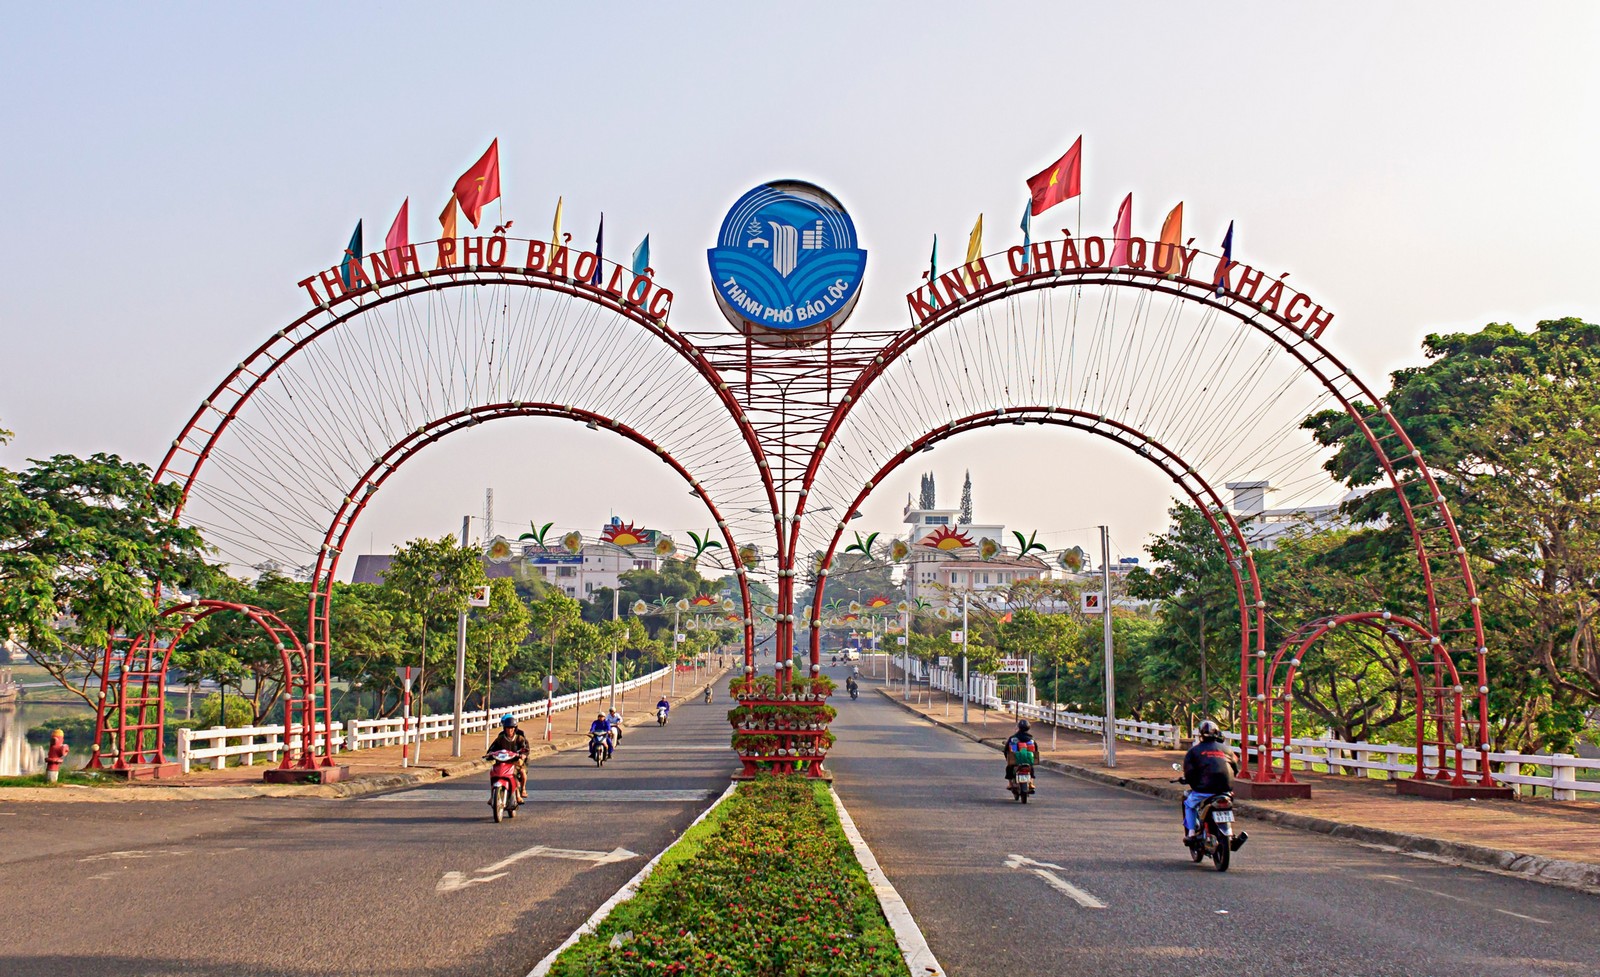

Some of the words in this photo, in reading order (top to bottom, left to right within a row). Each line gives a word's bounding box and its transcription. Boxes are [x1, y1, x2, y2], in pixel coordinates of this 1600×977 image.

[297, 243, 421, 306] THÀNH
[437, 220, 513, 269] PHỐ
[526, 232, 598, 283] BẢO
[606, 267, 673, 319] LỘC
[723, 276, 763, 316] THÀNH
[763, 304, 794, 323] PHỐ
[796, 300, 826, 321] BẢO
[827, 278, 849, 306] LỘC
[906, 257, 993, 321] KÍNH
[1007, 228, 1105, 277] CHÀO
[1127, 237, 1199, 278] QUÝ
[1214, 260, 1335, 339] KHÁCH
